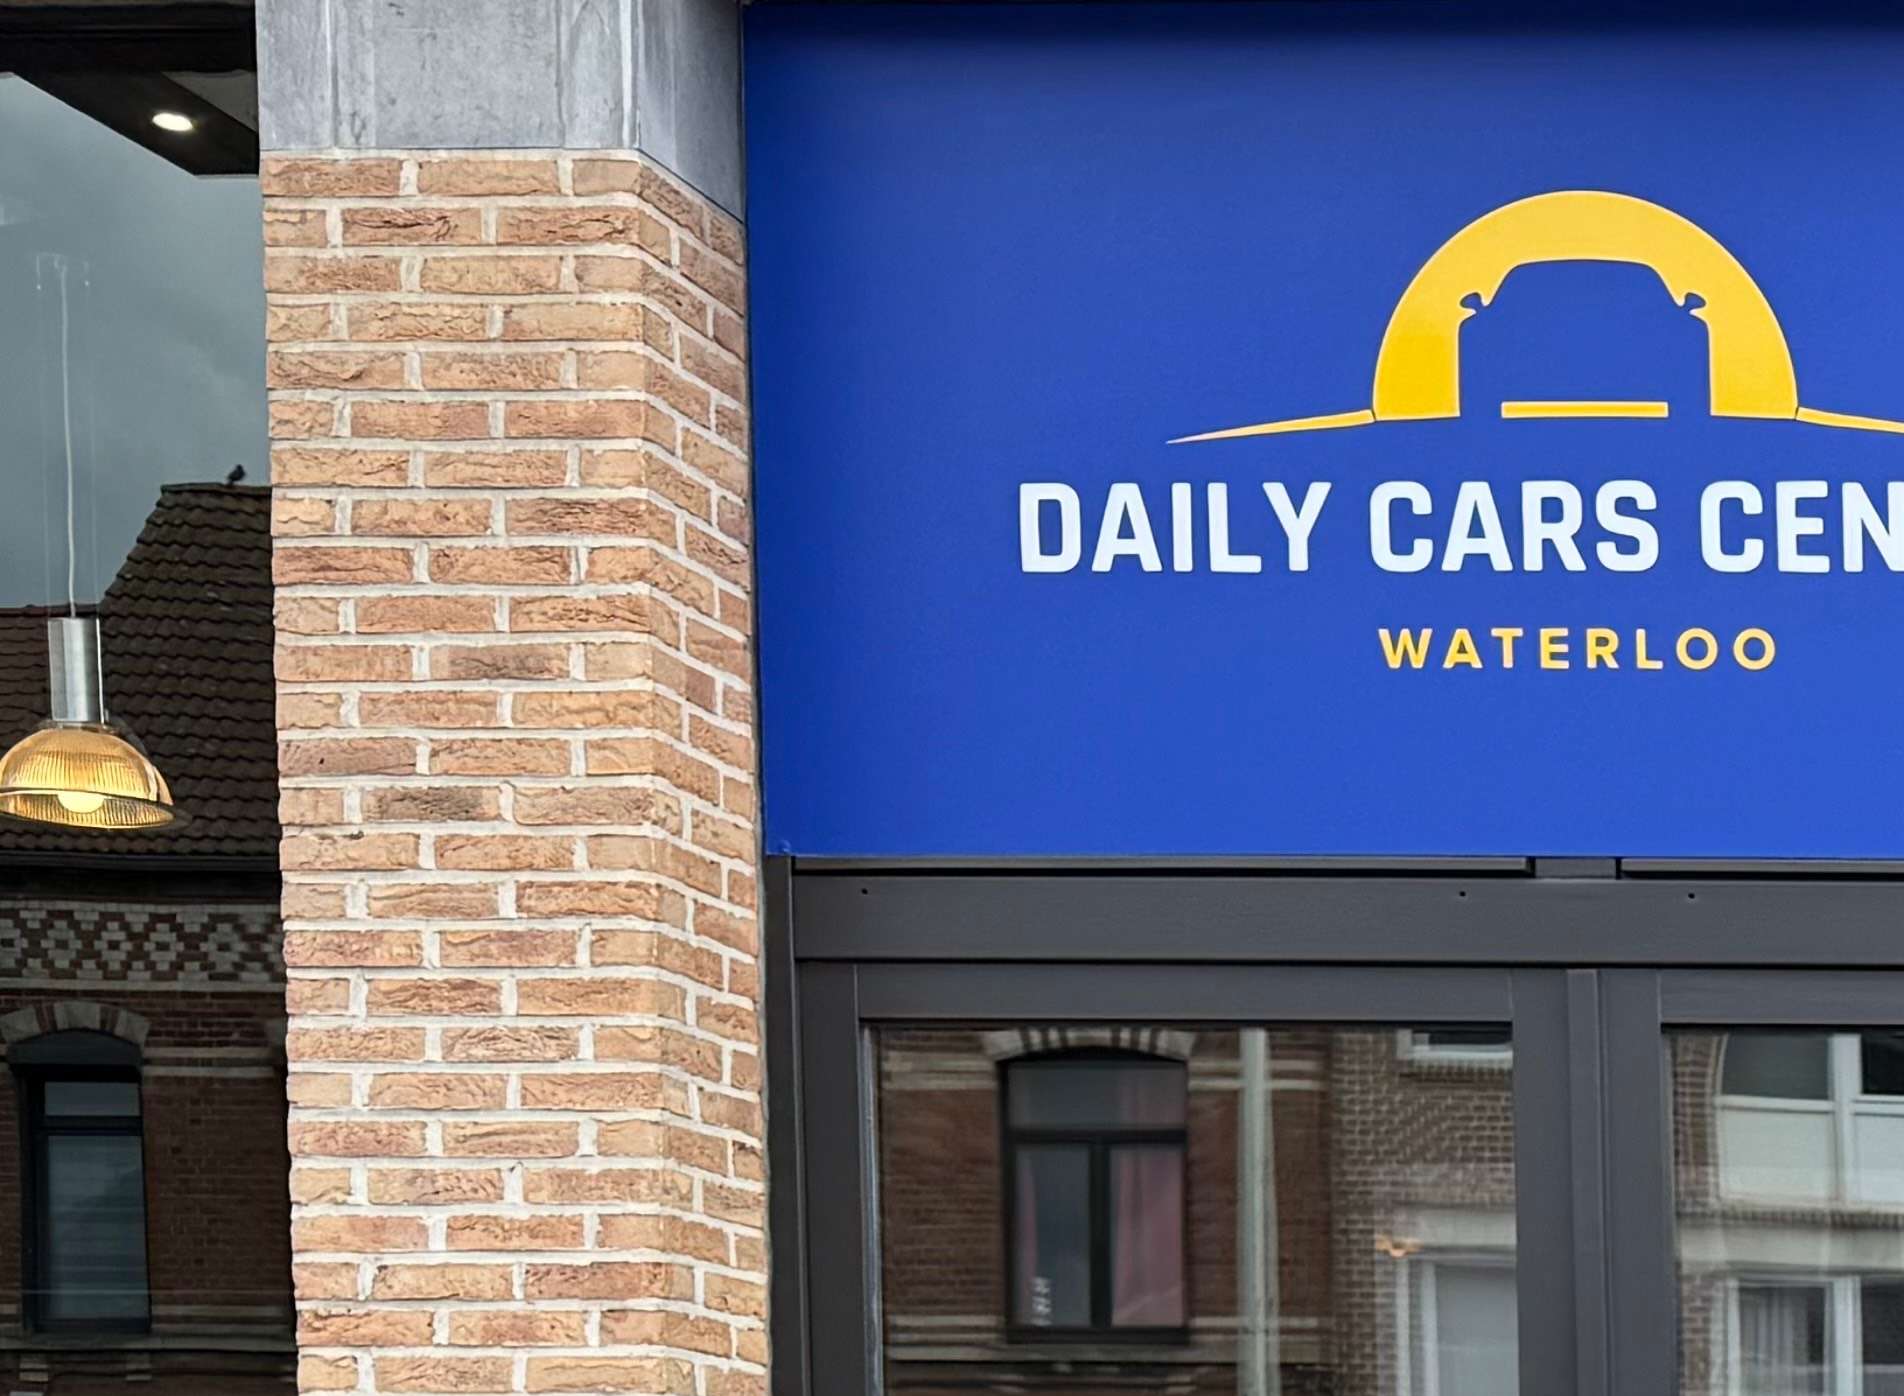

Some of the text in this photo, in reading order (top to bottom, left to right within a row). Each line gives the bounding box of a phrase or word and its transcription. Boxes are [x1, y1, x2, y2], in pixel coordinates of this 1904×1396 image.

[1017, 481, 1332, 576] DAILY
[1369, 479, 1661, 573] CARS
[1378, 627, 1779, 671] WATERLOO
